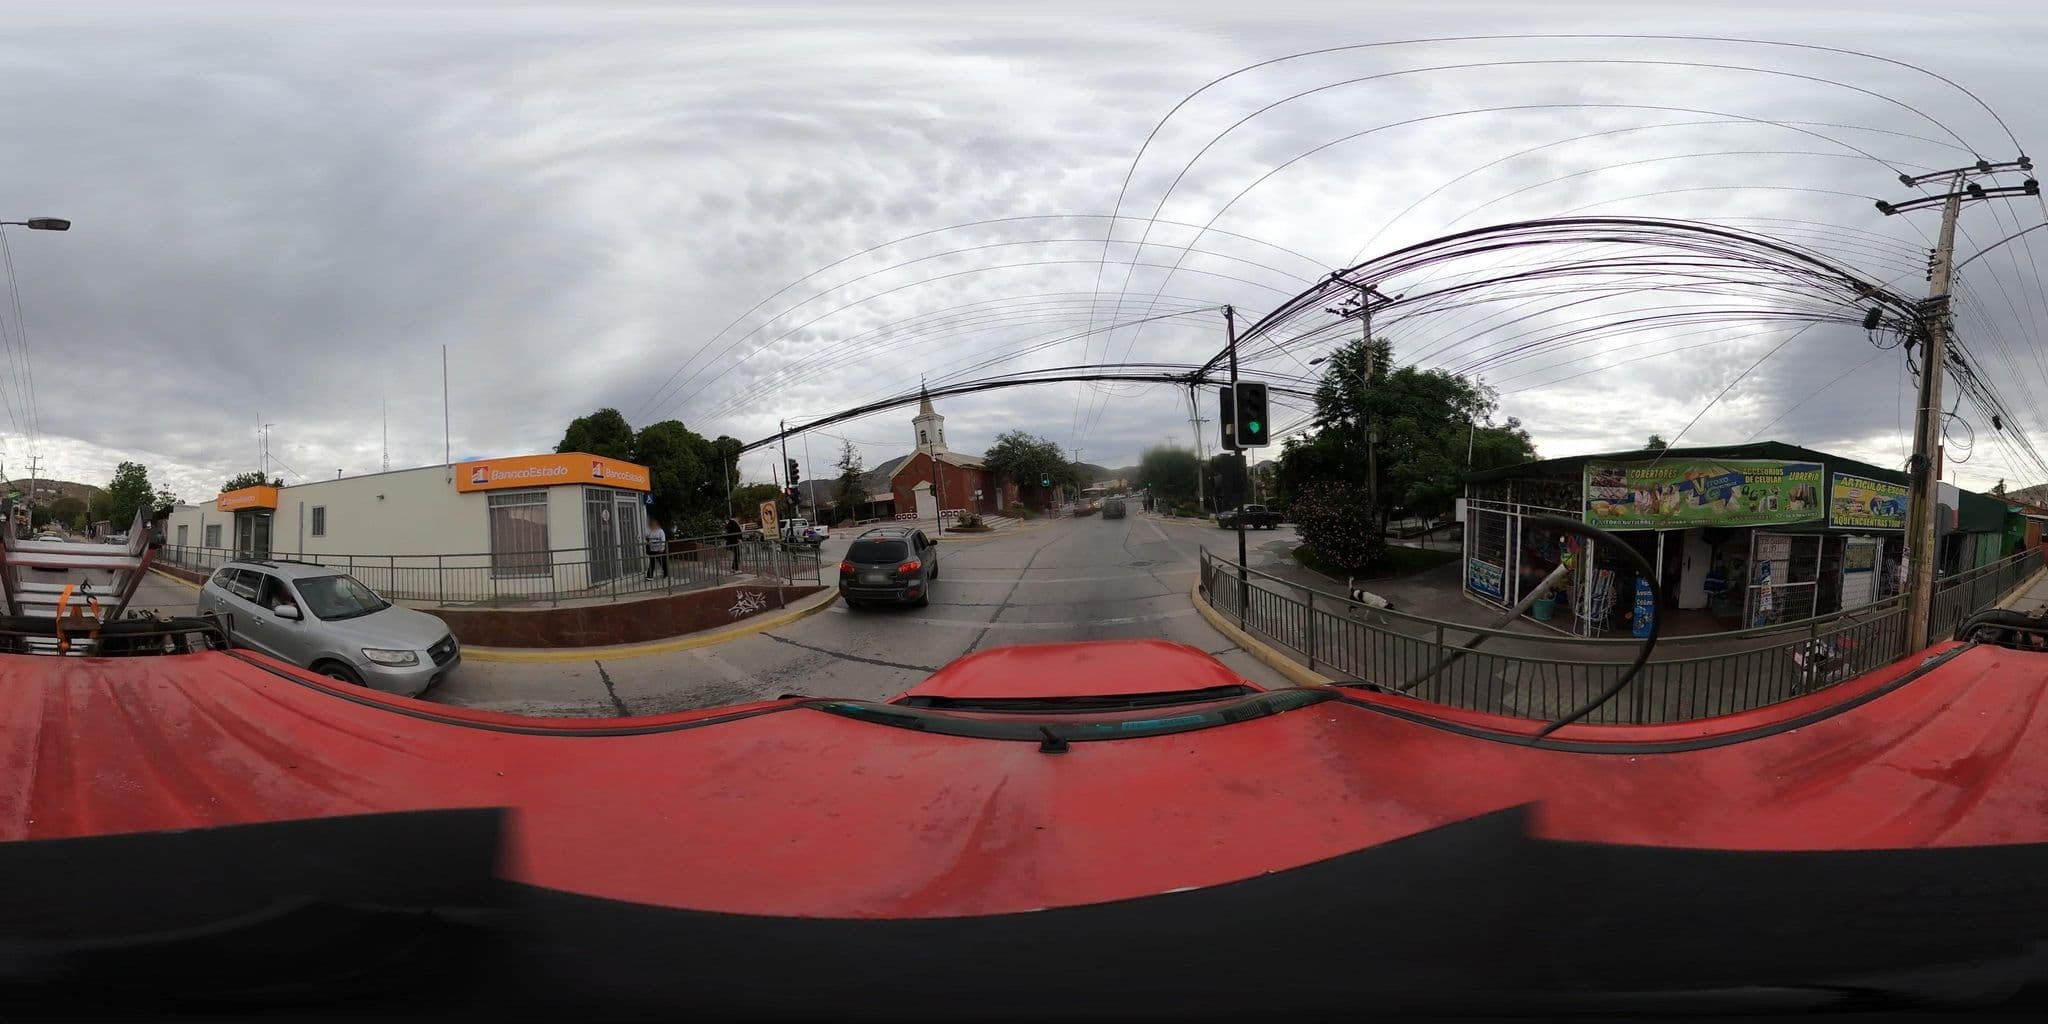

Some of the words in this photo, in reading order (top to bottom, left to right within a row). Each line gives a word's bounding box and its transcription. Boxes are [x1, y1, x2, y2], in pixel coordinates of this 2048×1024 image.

[606, 469, 645, 484] BancoEstado
[1743, 466, 1784, 476] ACCESORIOS
[1745, 475, 1753, 483] DE
[1755, 475, 1782, 484] CELULAR
[1841, 477, 1886, 492] ARTICULOS
